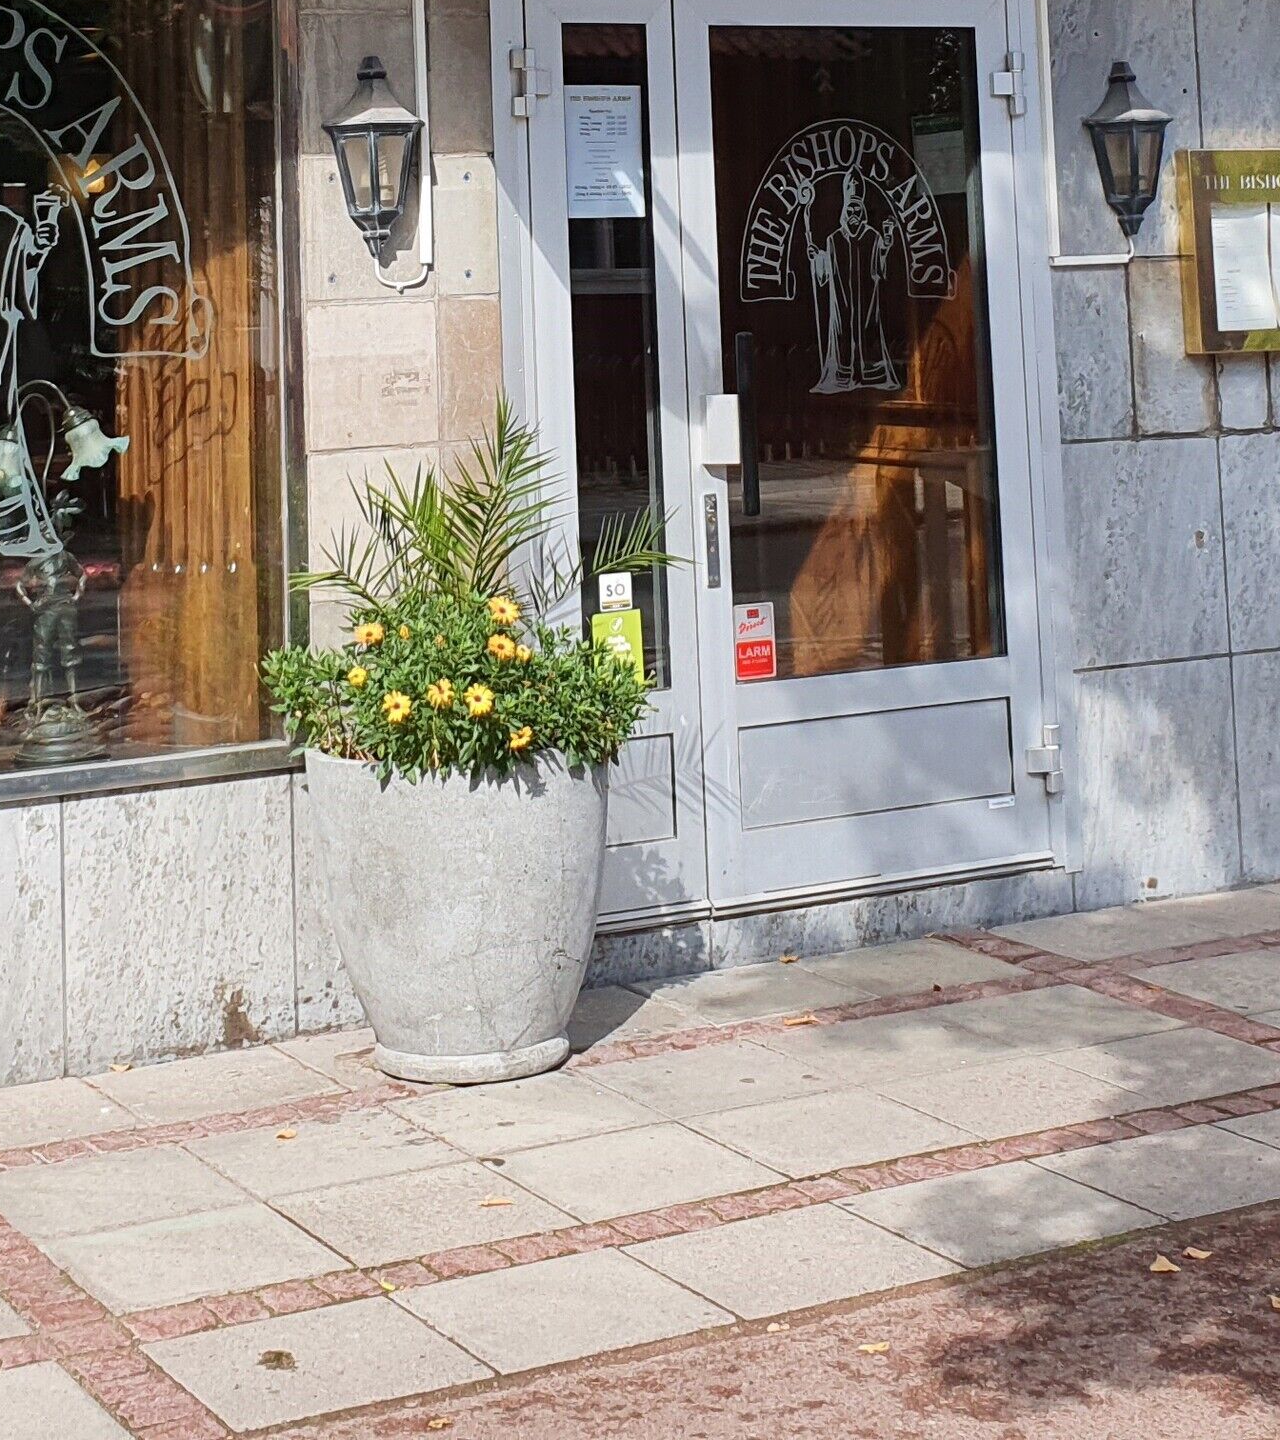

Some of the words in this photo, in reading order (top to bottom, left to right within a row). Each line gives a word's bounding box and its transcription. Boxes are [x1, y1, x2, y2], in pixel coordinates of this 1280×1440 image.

[46, 96, 181, 328] ARMS
[763, 124, 896, 216] BISHOPS
[746, 213, 791, 290] THE
[886, 177, 946, 288] ARMS
[739, 645, 771, 659] LARM
